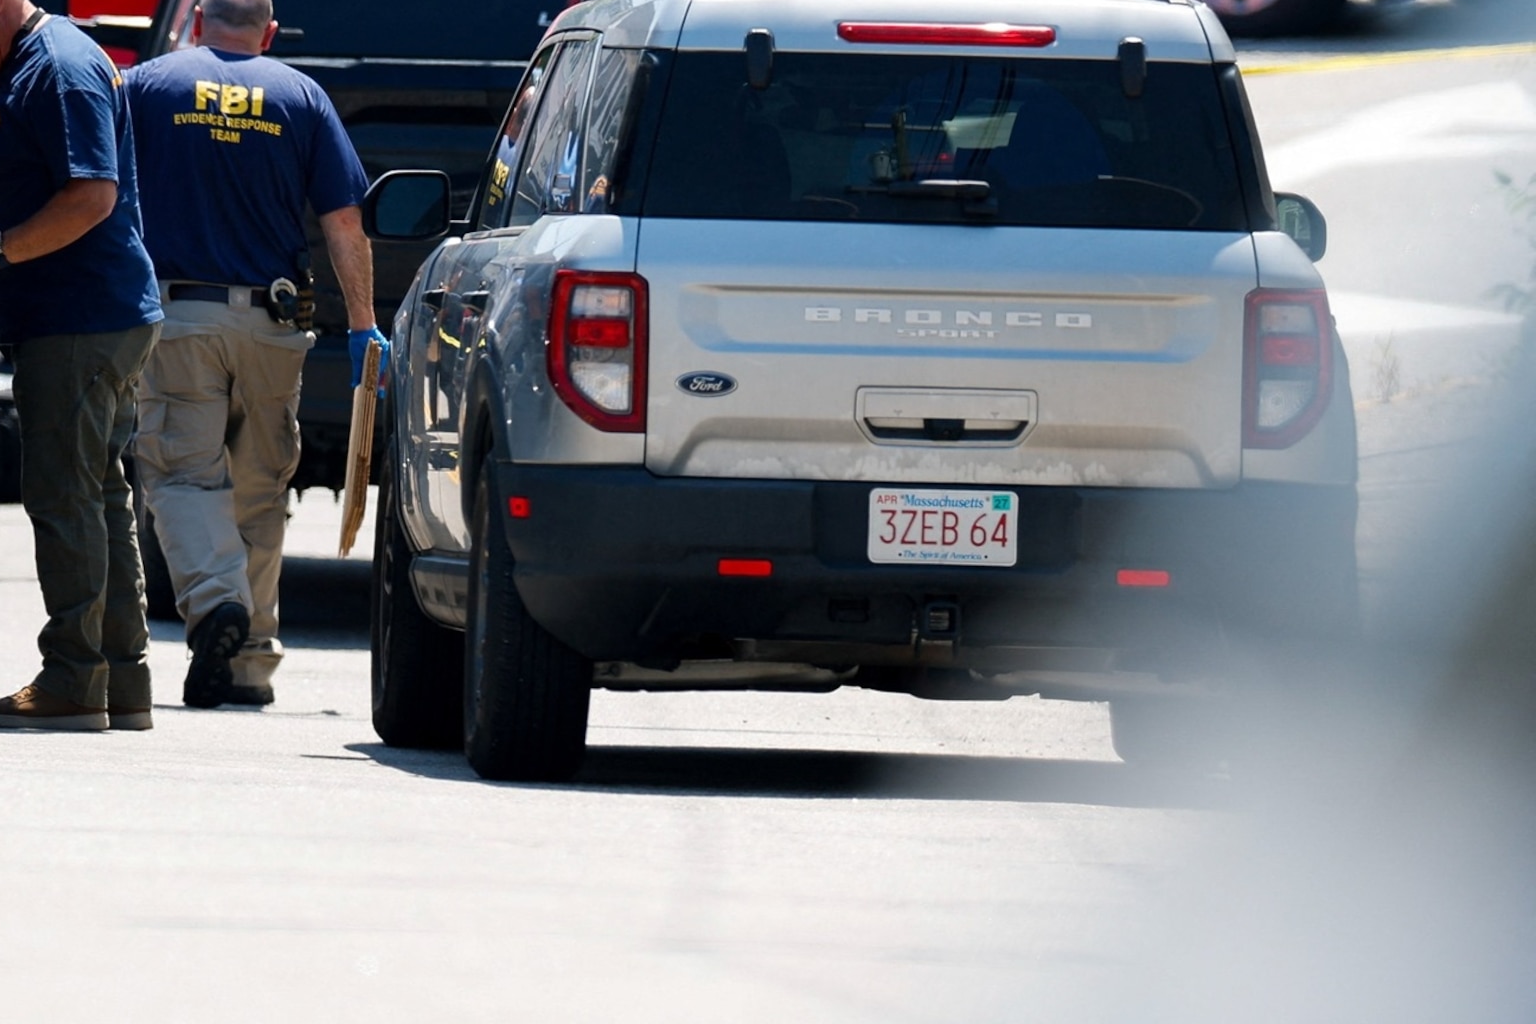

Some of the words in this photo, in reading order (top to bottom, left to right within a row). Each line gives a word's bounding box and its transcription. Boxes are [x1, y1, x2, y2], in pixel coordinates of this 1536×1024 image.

[195, 80, 265, 117] FBI
[173, 113, 226, 126] EVIDENCE
[226, 117, 282, 136] RESPONSE
[210, 128, 241, 144] TEAM
[804, 307, 1093, 328] BRONCO
[896, 328, 998, 339] SPORT
[689, 376, 724, 391] Ford
[876, 495, 898, 504] APR
[904, 495, 984, 509] Massachusetts
[994, 498, 1009, 509] 27
[879, 509, 959, 546] 3ZEB
[969, 513, 1008, 547] 64
[903, 550, 916, 558] The
[919, 551, 938, 559] Spirit
[950, 552, 982, 560] America
